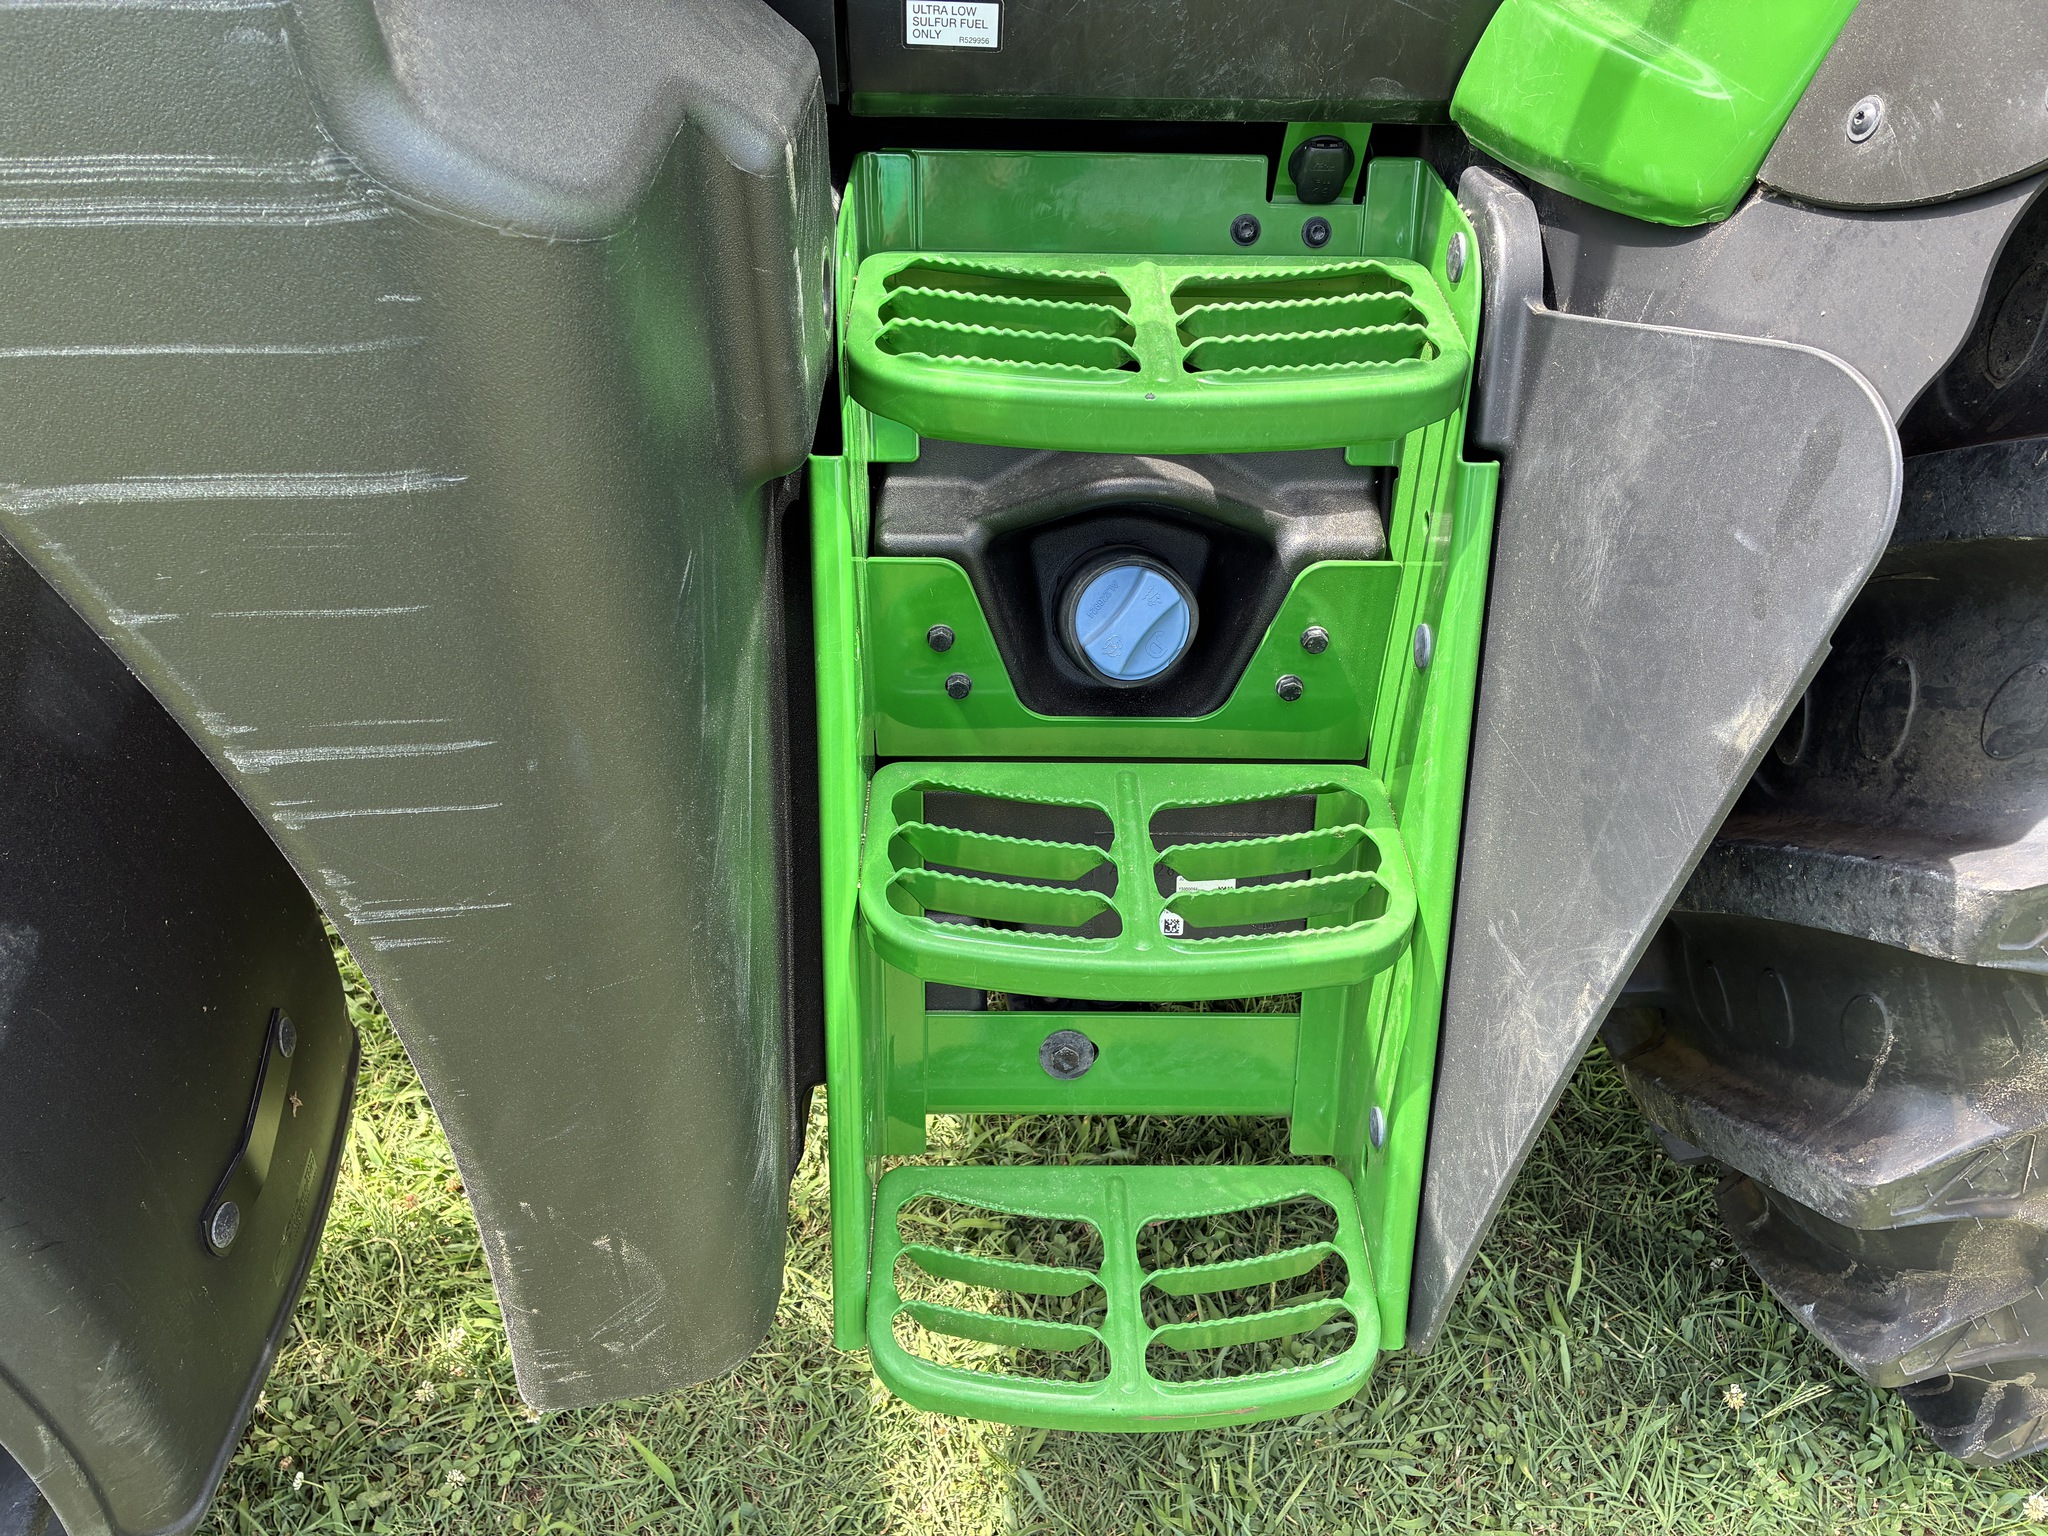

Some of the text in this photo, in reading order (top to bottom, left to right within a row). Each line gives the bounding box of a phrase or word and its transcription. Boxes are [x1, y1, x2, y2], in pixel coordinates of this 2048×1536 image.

[912, 4, 977, 16] ULTRA LOW
[912, 16, 989, 29] SULFUR FUEL
[912, 29, 942, 39] ONLY
[959, 36, 990, 44] R529956
